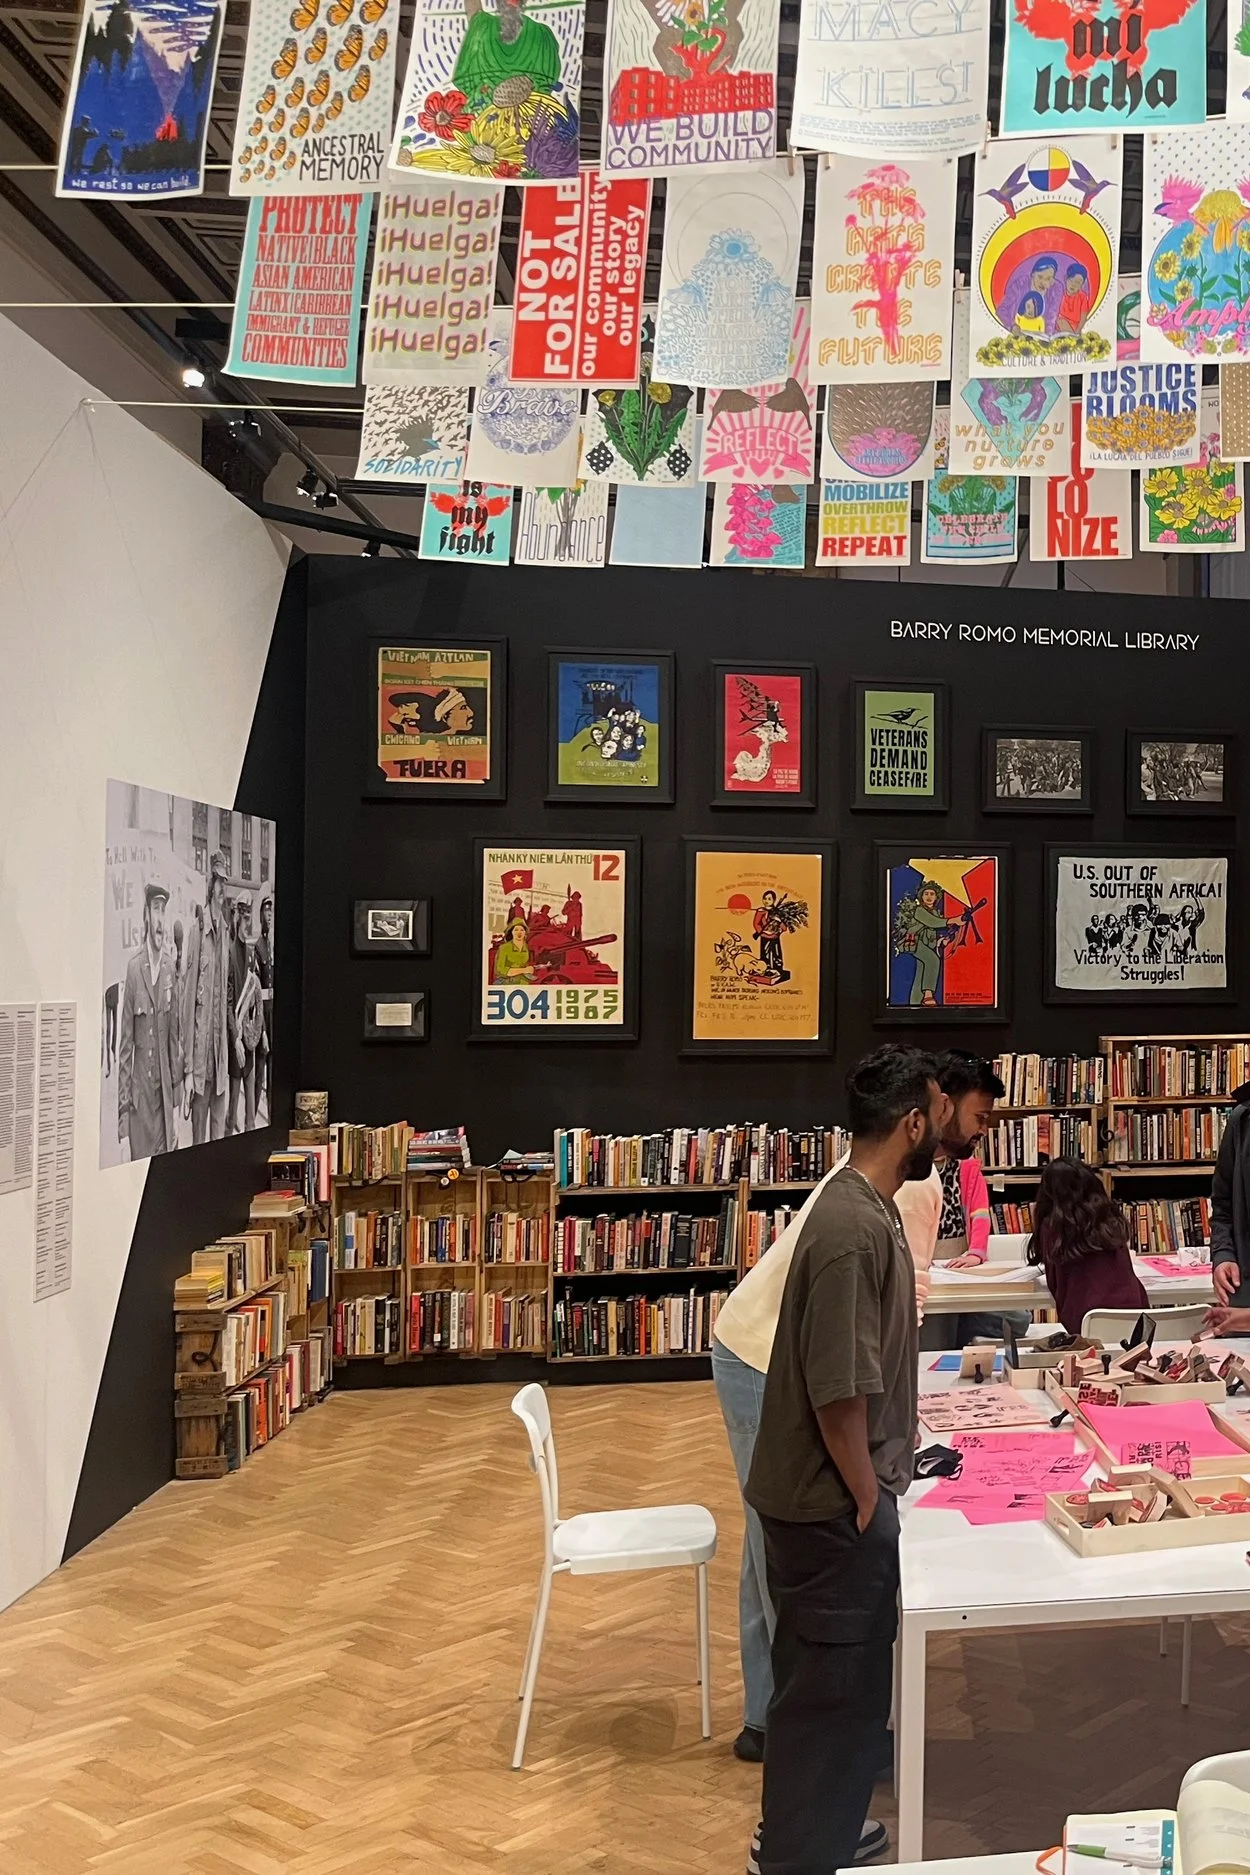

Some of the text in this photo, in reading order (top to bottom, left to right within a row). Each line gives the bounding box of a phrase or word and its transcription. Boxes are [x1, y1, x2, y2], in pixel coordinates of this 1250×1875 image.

[1033, 57, 1178, 119] lucha
[608, 115, 664, 146] WE
[675, 109, 774, 141] BUILD
[301, 131, 384, 157] ANCESTRAL
[606, 136, 774, 168] COMMUNITY
[299, 154, 385, 181] MEMORY
[260, 195, 364, 235] PROTECT
[846, 223, 925, 256] ARTS
[252, 263, 355, 292] ASIAN AMERICAN
[518, 230, 551, 322] NOT
[544, 183, 582, 375] FOR SALE
[582, 176, 612, 377] our community
[602, 215, 627, 337] our story
[618, 205, 645, 347] our legacy
[246, 313, 300, 335] IMMIGRANT
[242, 333, 348, 369] COMMUNITIES
[818, 332, 942, 367] FUTURE
[1087, 363, 1196, 394] JUSTICE
[1086, 389, 1197, 419] BLOOMS
[955, 420, 1065, 438] what you
[722, 428, 799, 458] REFLECT
[965, 437, 1055, 453] nurture
[364, 455, 463, 478] SOLIDARITY
[973, 453, 1046, 471] grows
[824, 481, 909, 501] MOBILIZE
[451, 505, 489, 528] my
[823, 501, 909, 515] OVERTHROW
[822, 515, 908, 535] REFLECT
[439, 526, 496, 556] fight
[821, 535, 907, 557] REPEAT
[890, 620, 1200, 651] BARRY ROMO MEMORIAL LIBRARY
[387, 650, 474, 663] VIETNAM AZTLAN
[870, 728, 928, 750] VETERANS
[393, 759, 466, 778] FUERA
[870, 750, 928, 771] DEMAND
[592, 854, 621, 881] 12
[1073, 864, 1158, 881] U.S. OUT OF
[1089, 882, 1223, 899] SOUTHERN AFRICA!
[1073, 948, 1224, 968] Victory to the Liberation
[1120, 965, 1185, 985] Struggles!
[556, 989, 619, 1005] 1975
[555, 1005, 618, 1020] 1987
